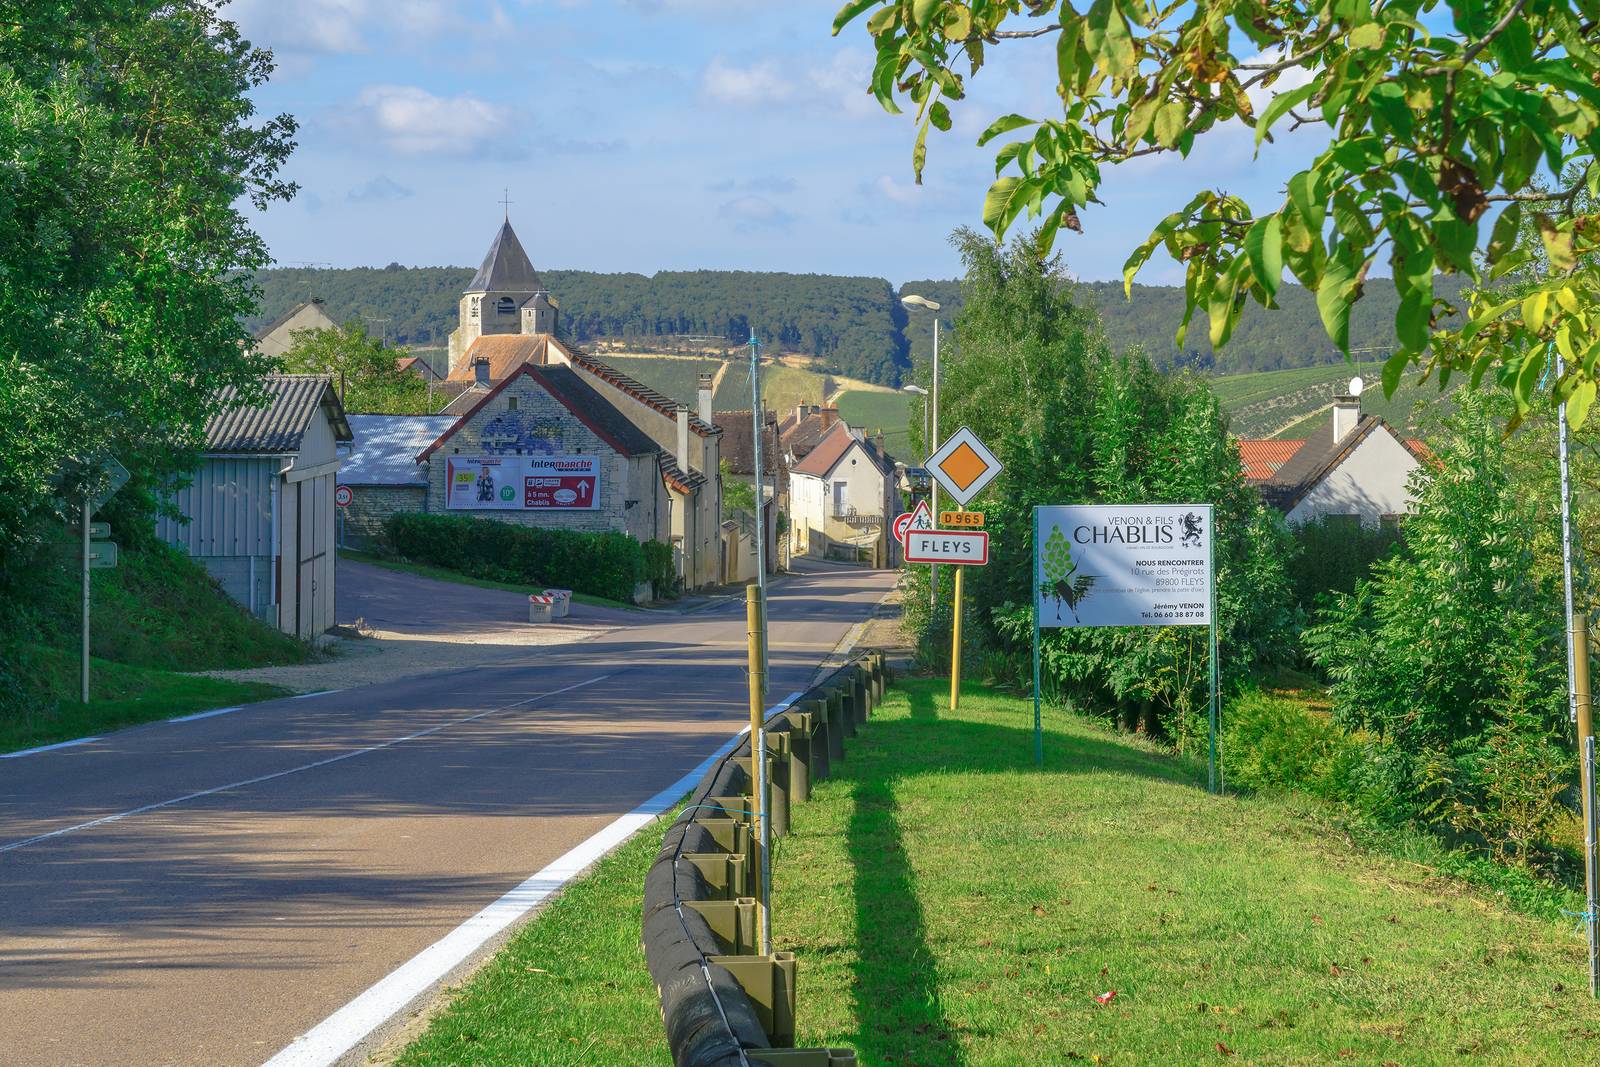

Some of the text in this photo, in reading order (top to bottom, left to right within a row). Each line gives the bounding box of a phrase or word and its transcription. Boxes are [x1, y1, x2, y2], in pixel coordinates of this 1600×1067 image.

[945, 514, 980, 524] D 965
[1108, 516, 1174, 525] VENON & FILS
[1074, 525, 1173, 544] CHABLIS
[922, 540, 970, 554] FLEYS
[1132, 568, 1140, 576] 10
[1156, 578, 1204, 586] 89800 FLEYS
